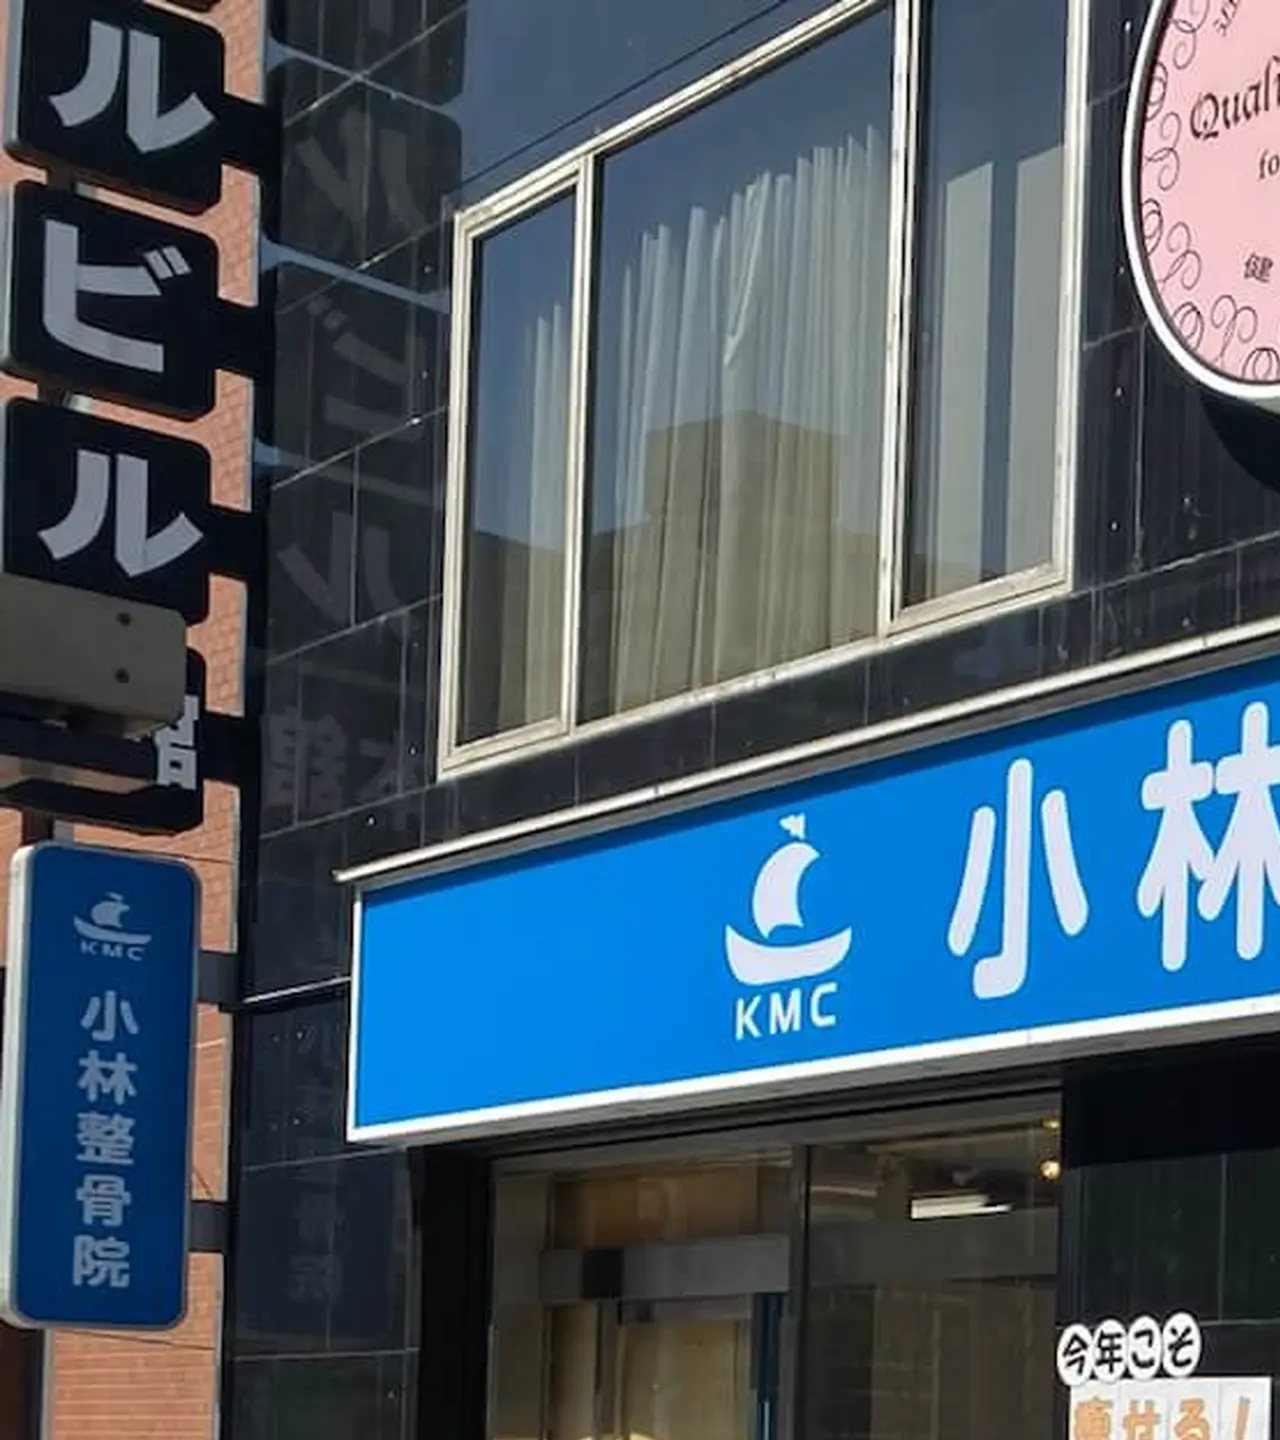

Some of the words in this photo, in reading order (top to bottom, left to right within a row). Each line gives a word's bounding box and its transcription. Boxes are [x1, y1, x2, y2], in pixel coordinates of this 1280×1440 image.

[80, 940, 145, 962] KMC
[734, 981, 838, 1041] KMC
[72, 990, 140, 1289] 小林整骨院
[1061, 1323, 1196, 1377] 今年こそ
